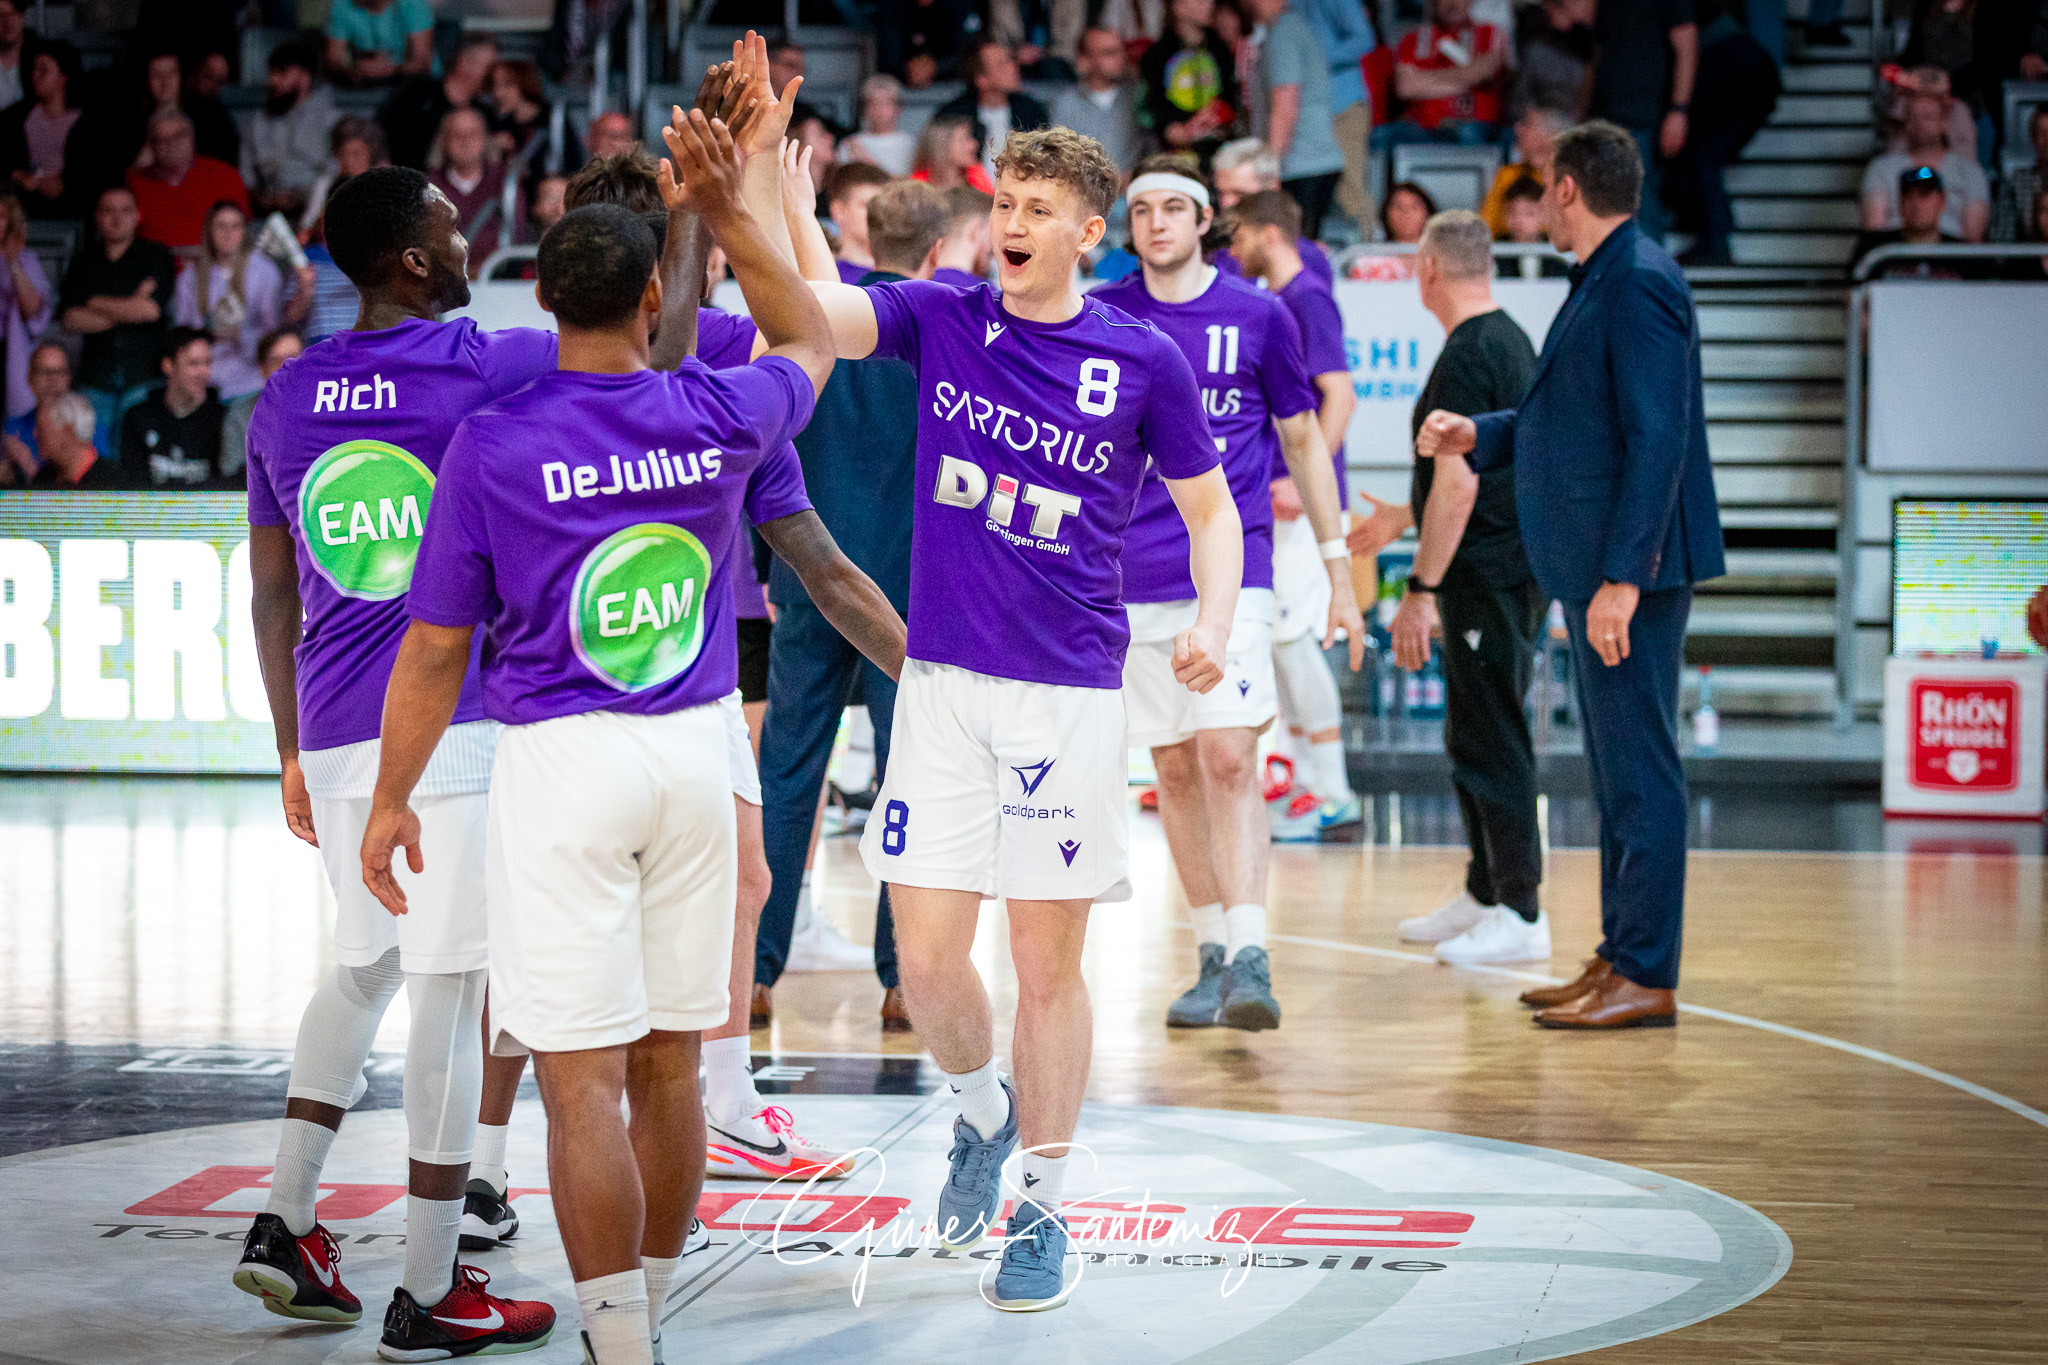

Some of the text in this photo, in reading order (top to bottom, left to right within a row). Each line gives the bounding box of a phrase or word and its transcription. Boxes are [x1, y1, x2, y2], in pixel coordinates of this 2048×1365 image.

[1205, 325, 1239, 374] 11
[313, 373, 396, 413] Rich
[1076, 357, 1121, 417] 8
[933, 381, 1114, 475] SARTORIUS
[542, 448, 722, 503] DeJulius
[318, 495, 424, 546] EAM
[1036, 540, 1070, 555] GmbH
[597, 578, 694, 637] EAM
[882, 799, 909, 857] 8
